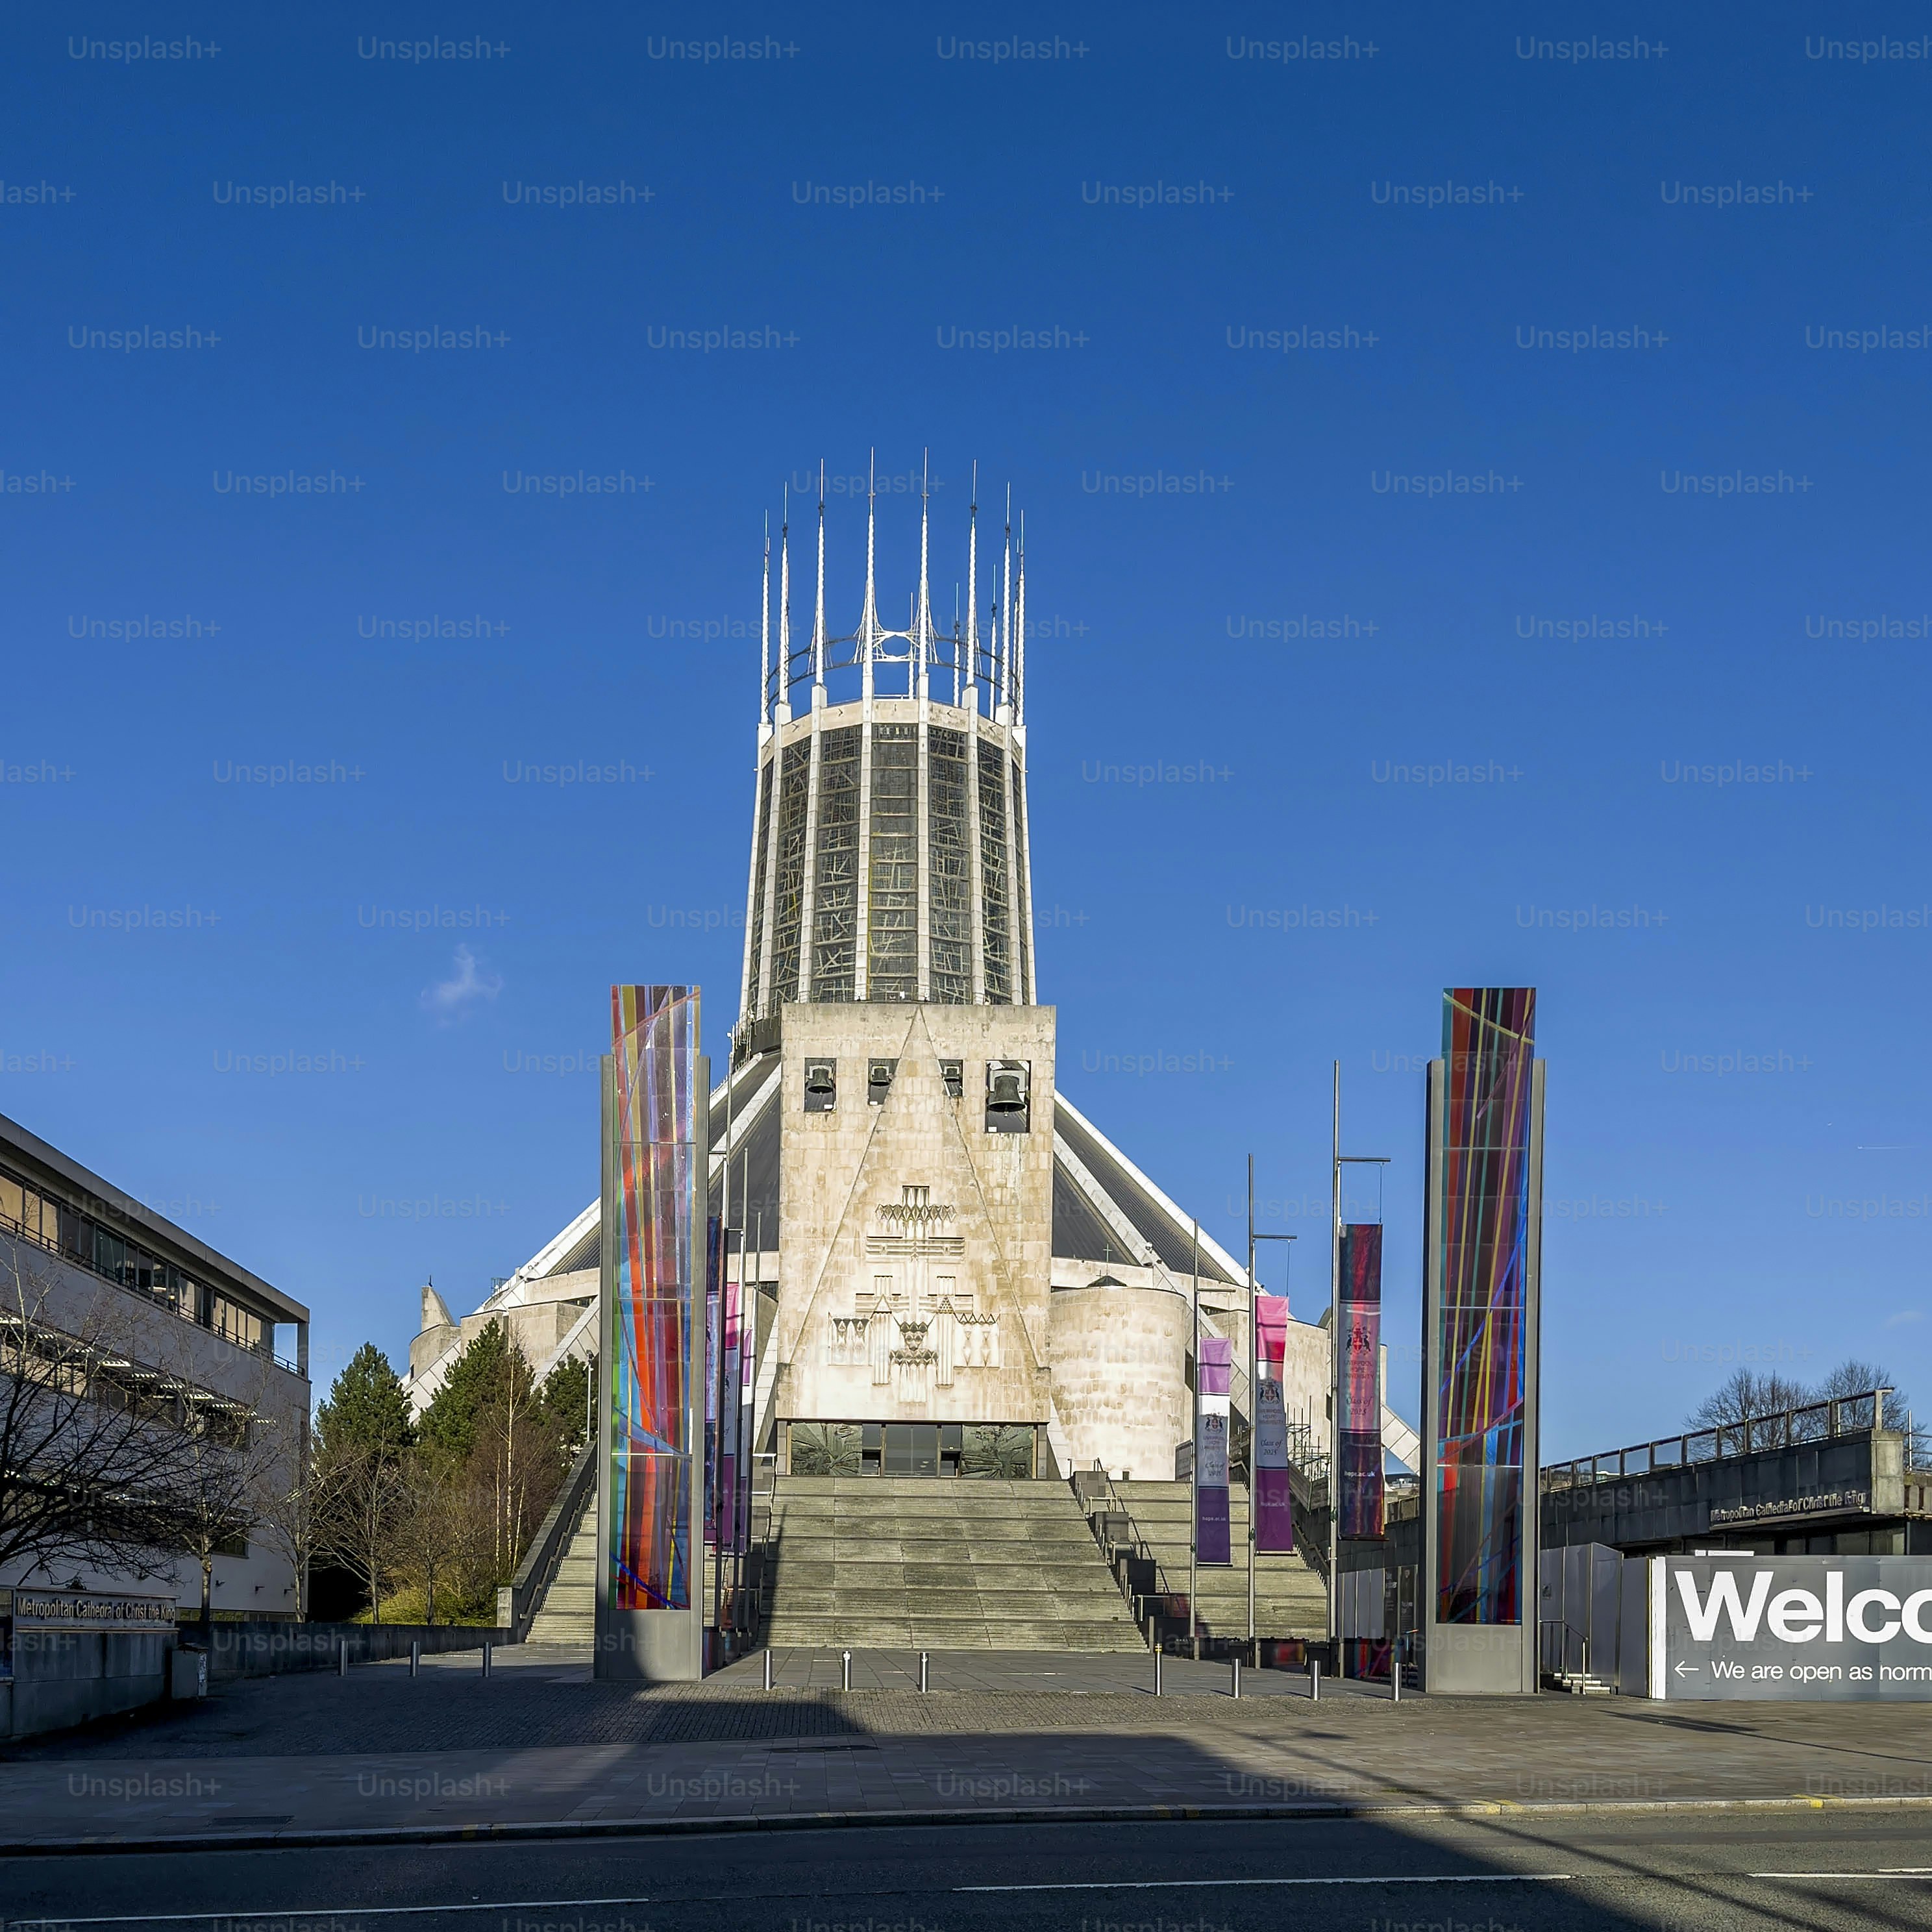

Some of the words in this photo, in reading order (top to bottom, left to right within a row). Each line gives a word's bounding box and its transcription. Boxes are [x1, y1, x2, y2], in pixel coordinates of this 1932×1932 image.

[17, 1597, 74, 1620] Metropolitan
[76, 1600, 114, 1618] Cathedral
[116, 1602, 125, 1618] of
[126, 1602, 147, 1619] Christ
[148, 1604, 160, 1620] the
[160, 1604, 176, 1622] King
[1711, 1661, 1745, 1680] We
[1752, 1665, 1784, 1680] are
[1790, 1665, 1842, 1683] open
[1849, 1665, 1873, 1680] as
